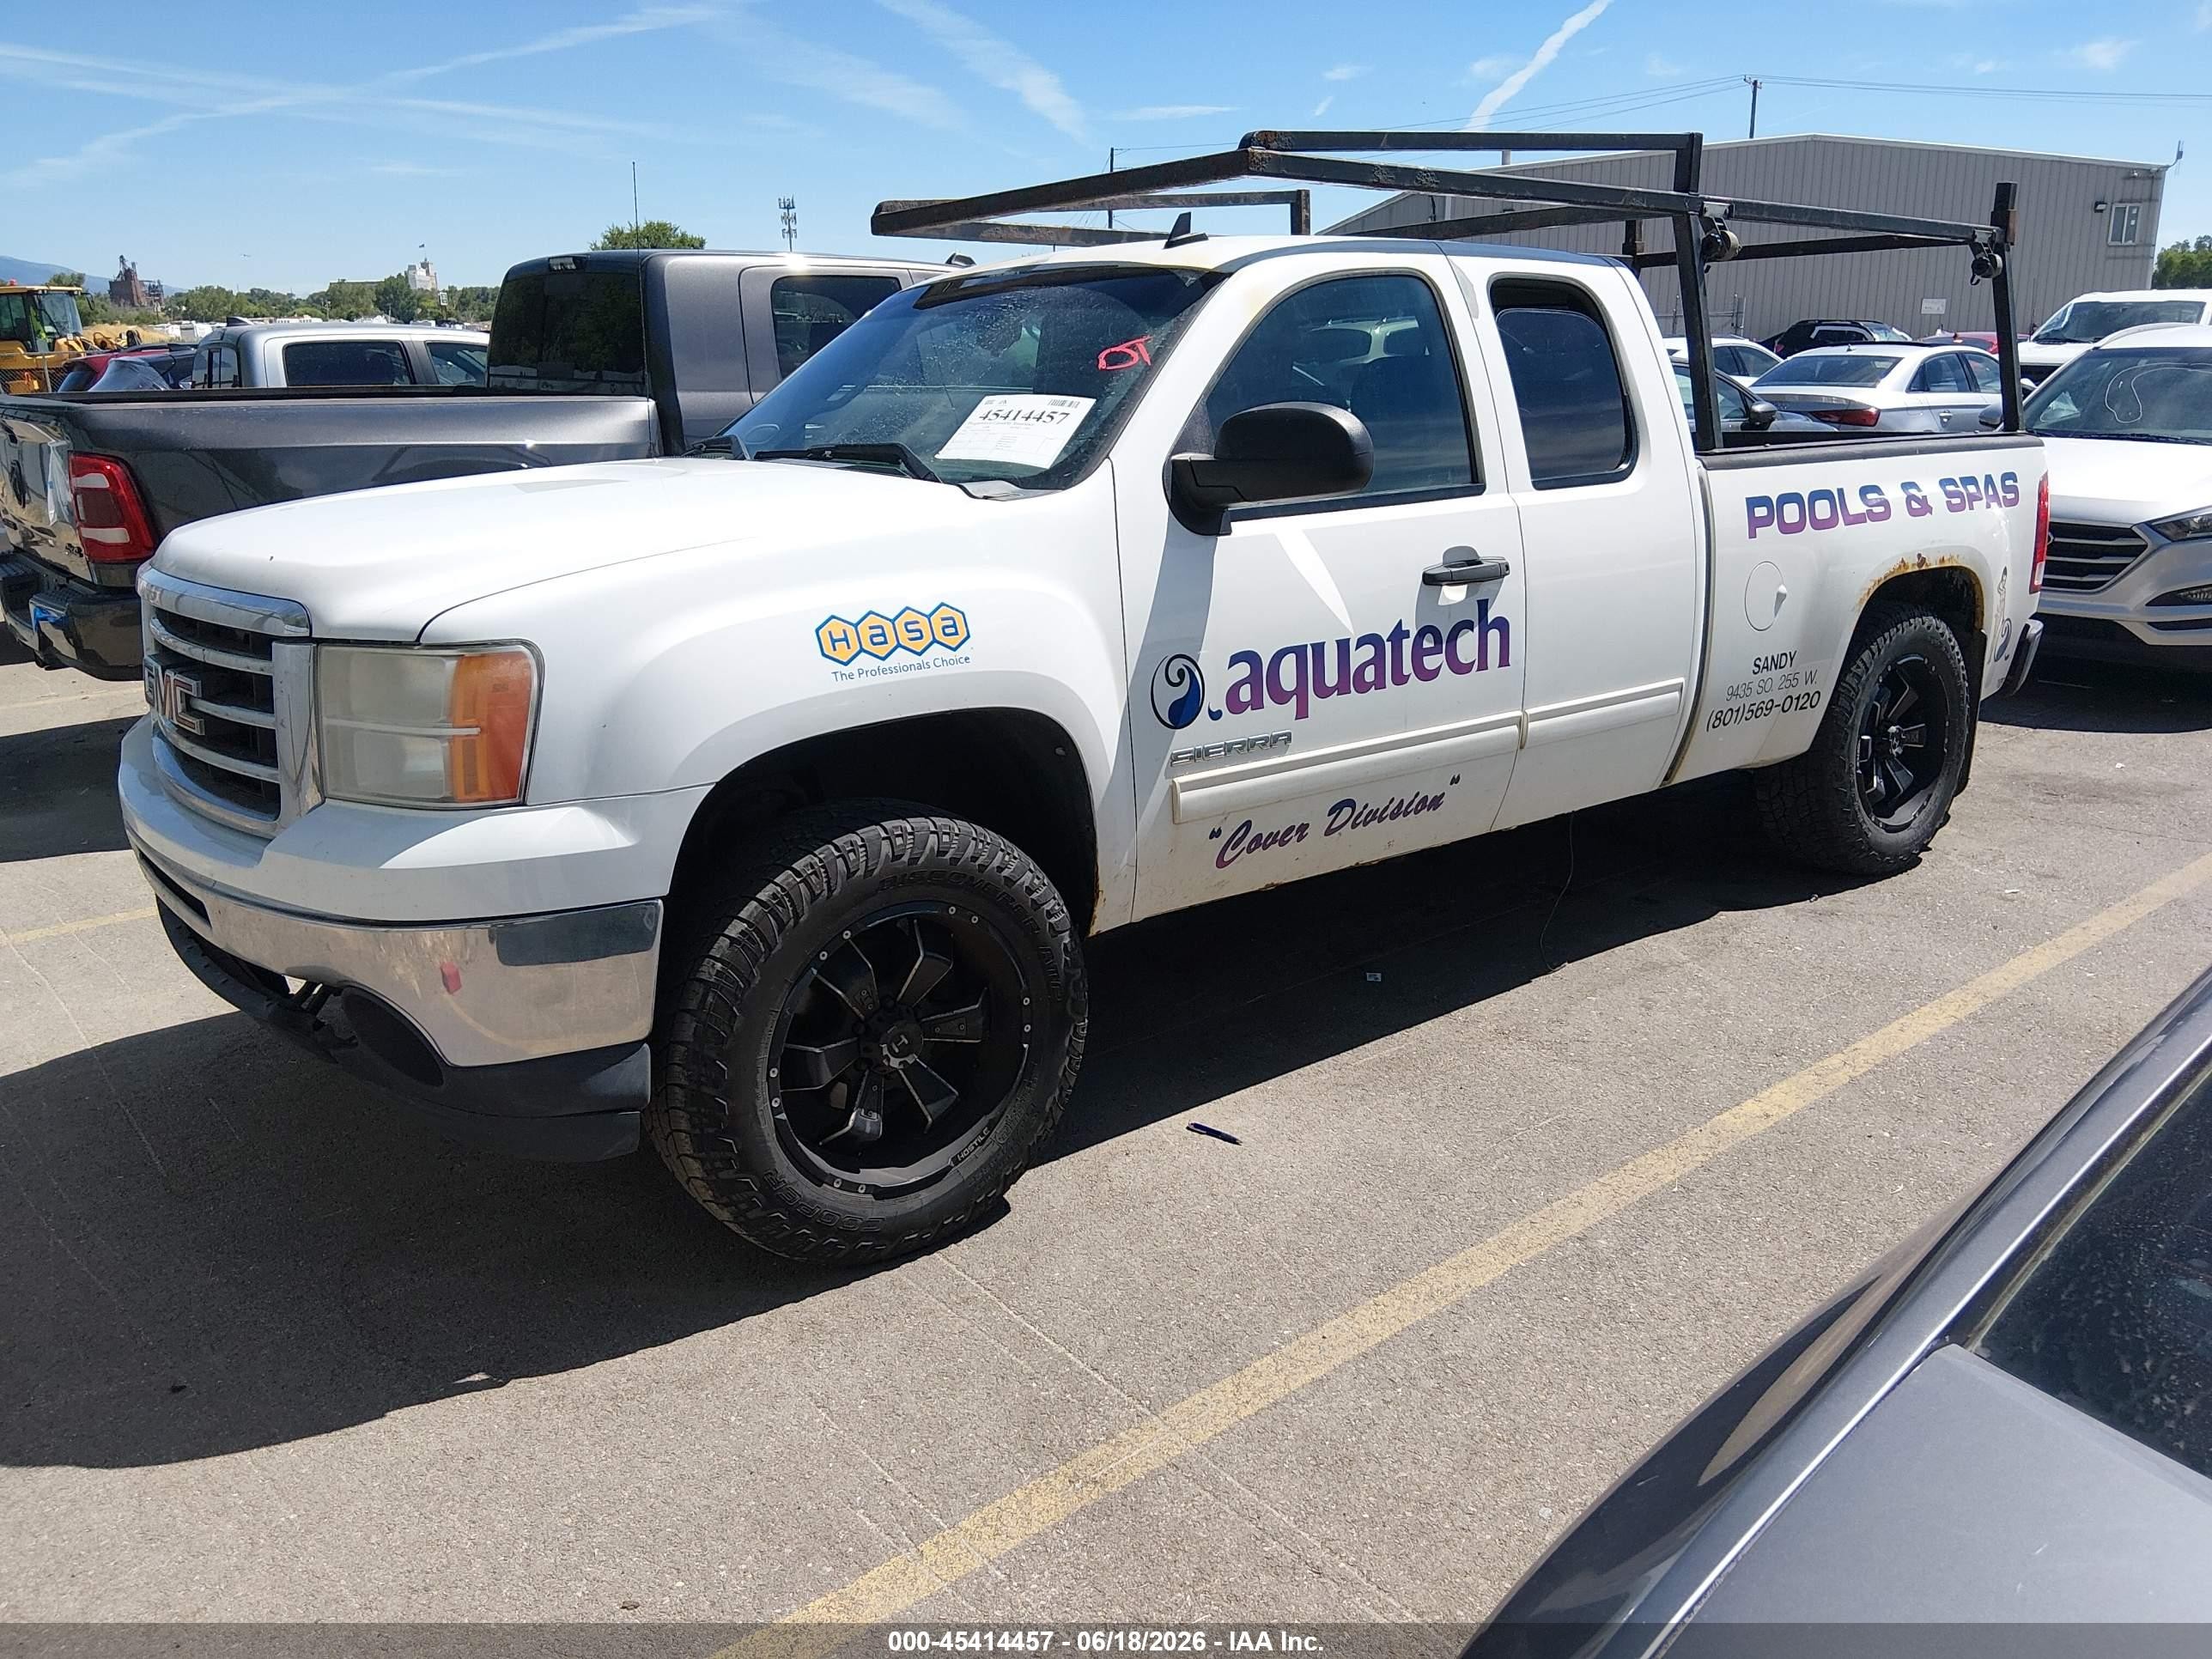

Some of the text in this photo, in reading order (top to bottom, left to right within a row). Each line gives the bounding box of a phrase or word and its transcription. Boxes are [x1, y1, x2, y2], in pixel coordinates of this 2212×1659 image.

[980, 409, 1070, 426] 45414457
[1745, 471, 2019, 538] POOLS & SPAS
[831, 654, 970, 682] The Professionals Choice
[1225, 599, 1511, 720] aquatech
[1753, 650, 1797, 675] SANDY
[1726, 682, 1753, 702] 9435
[1778, 672, 1800, 690] 255
[1804, 668, 1818, 686] W.
[1706, 690, 1821, 732] (801)569-0120
[1170, 730, 1292, 767] SIERRA
